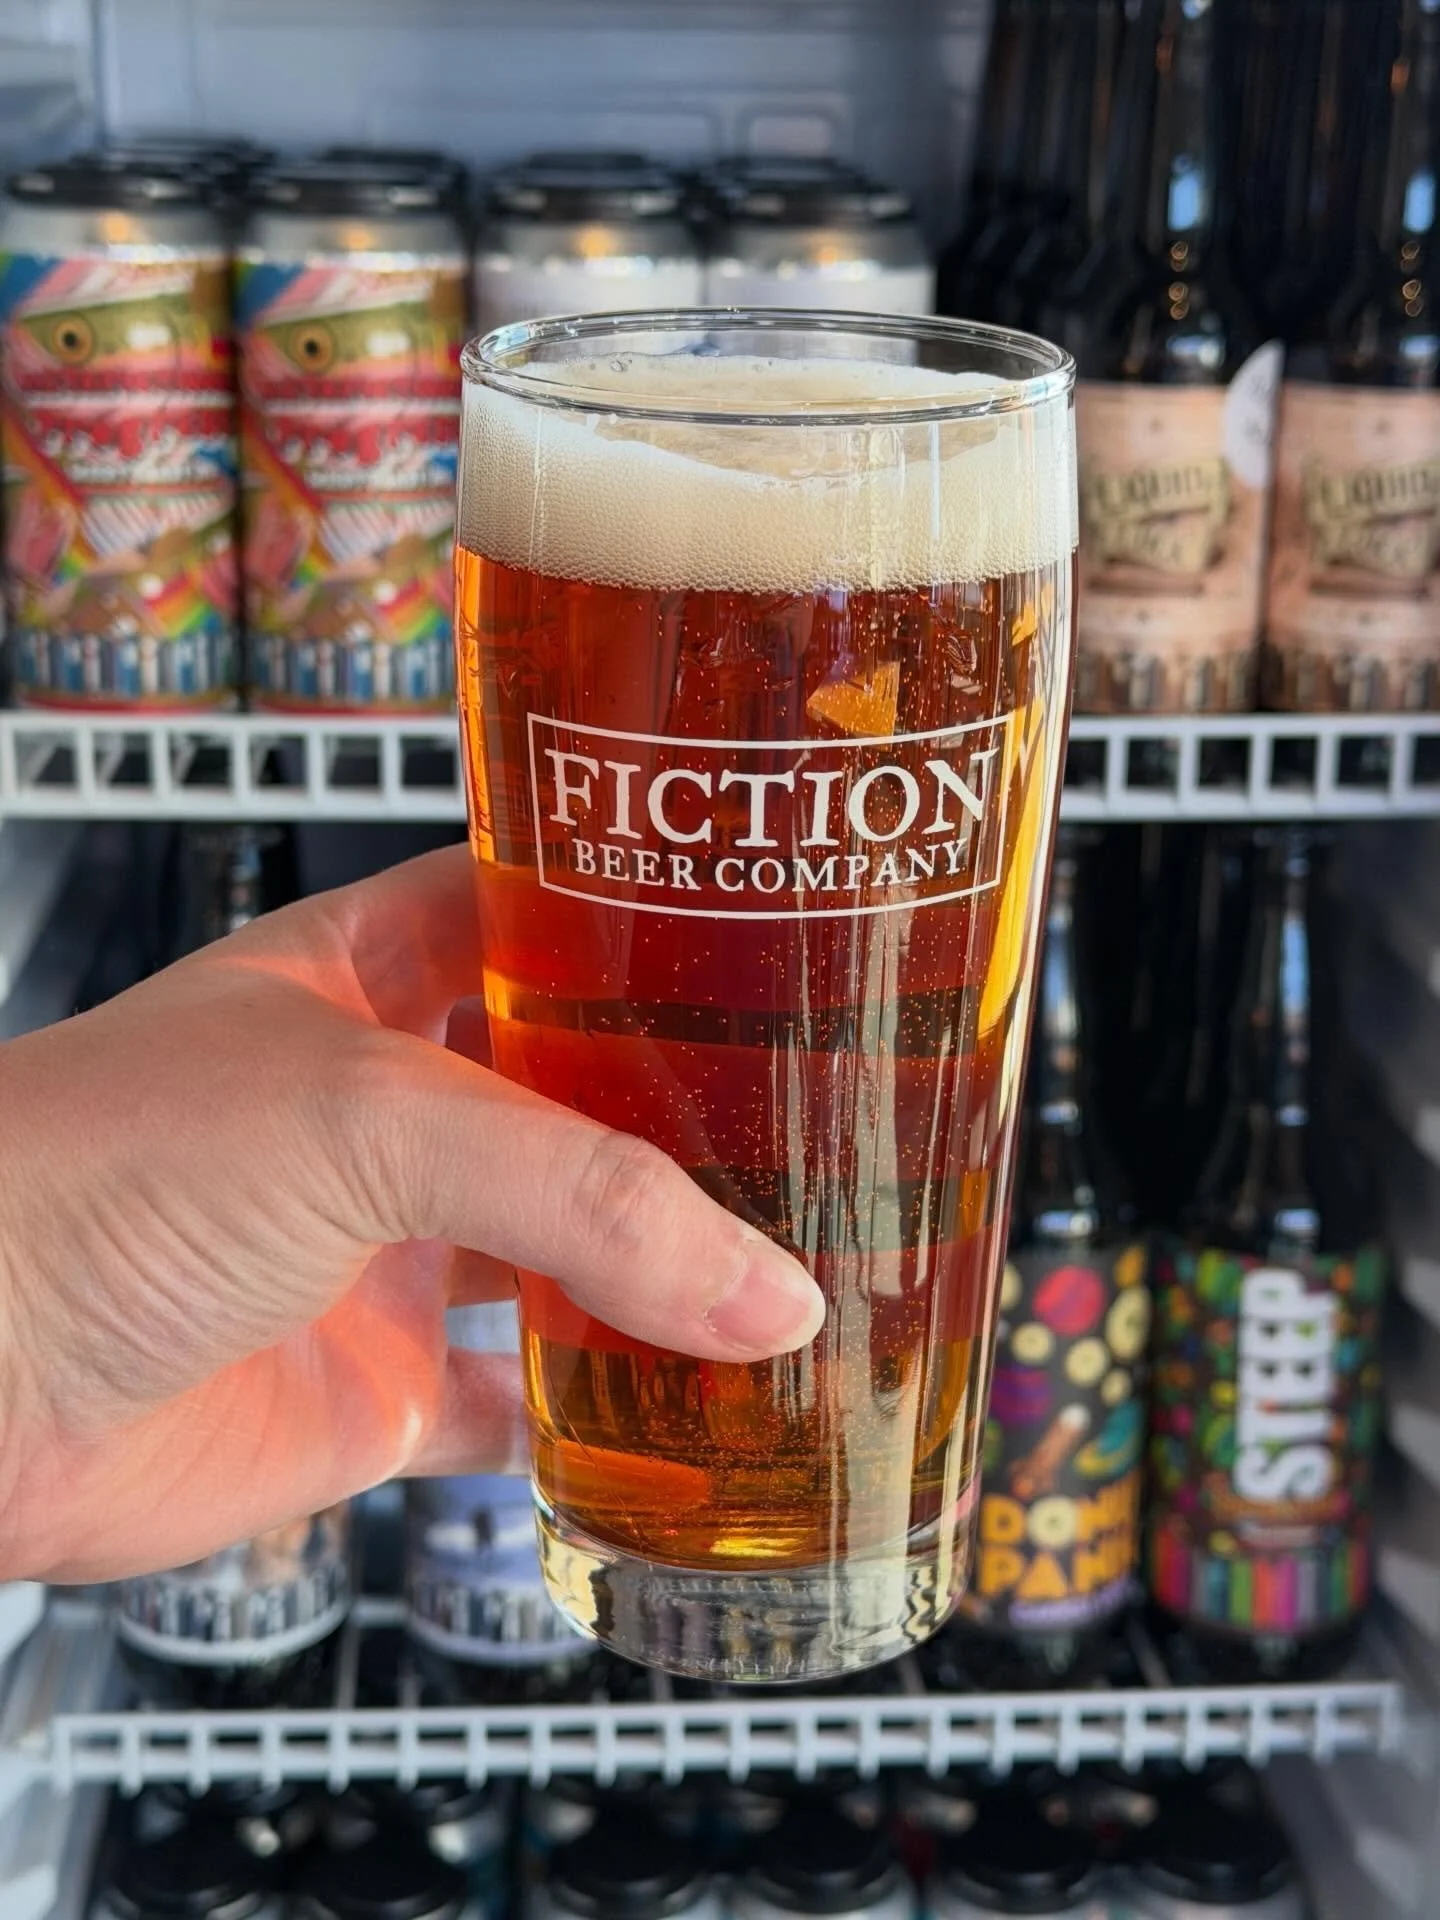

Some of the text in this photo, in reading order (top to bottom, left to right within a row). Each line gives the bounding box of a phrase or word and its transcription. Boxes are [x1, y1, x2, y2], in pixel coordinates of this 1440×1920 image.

[545, 748, 999, 848] FICTION
[572, 838, 968, 893] BEER COMPANY
[1234, 1268, 1335, 1499] STEEP
